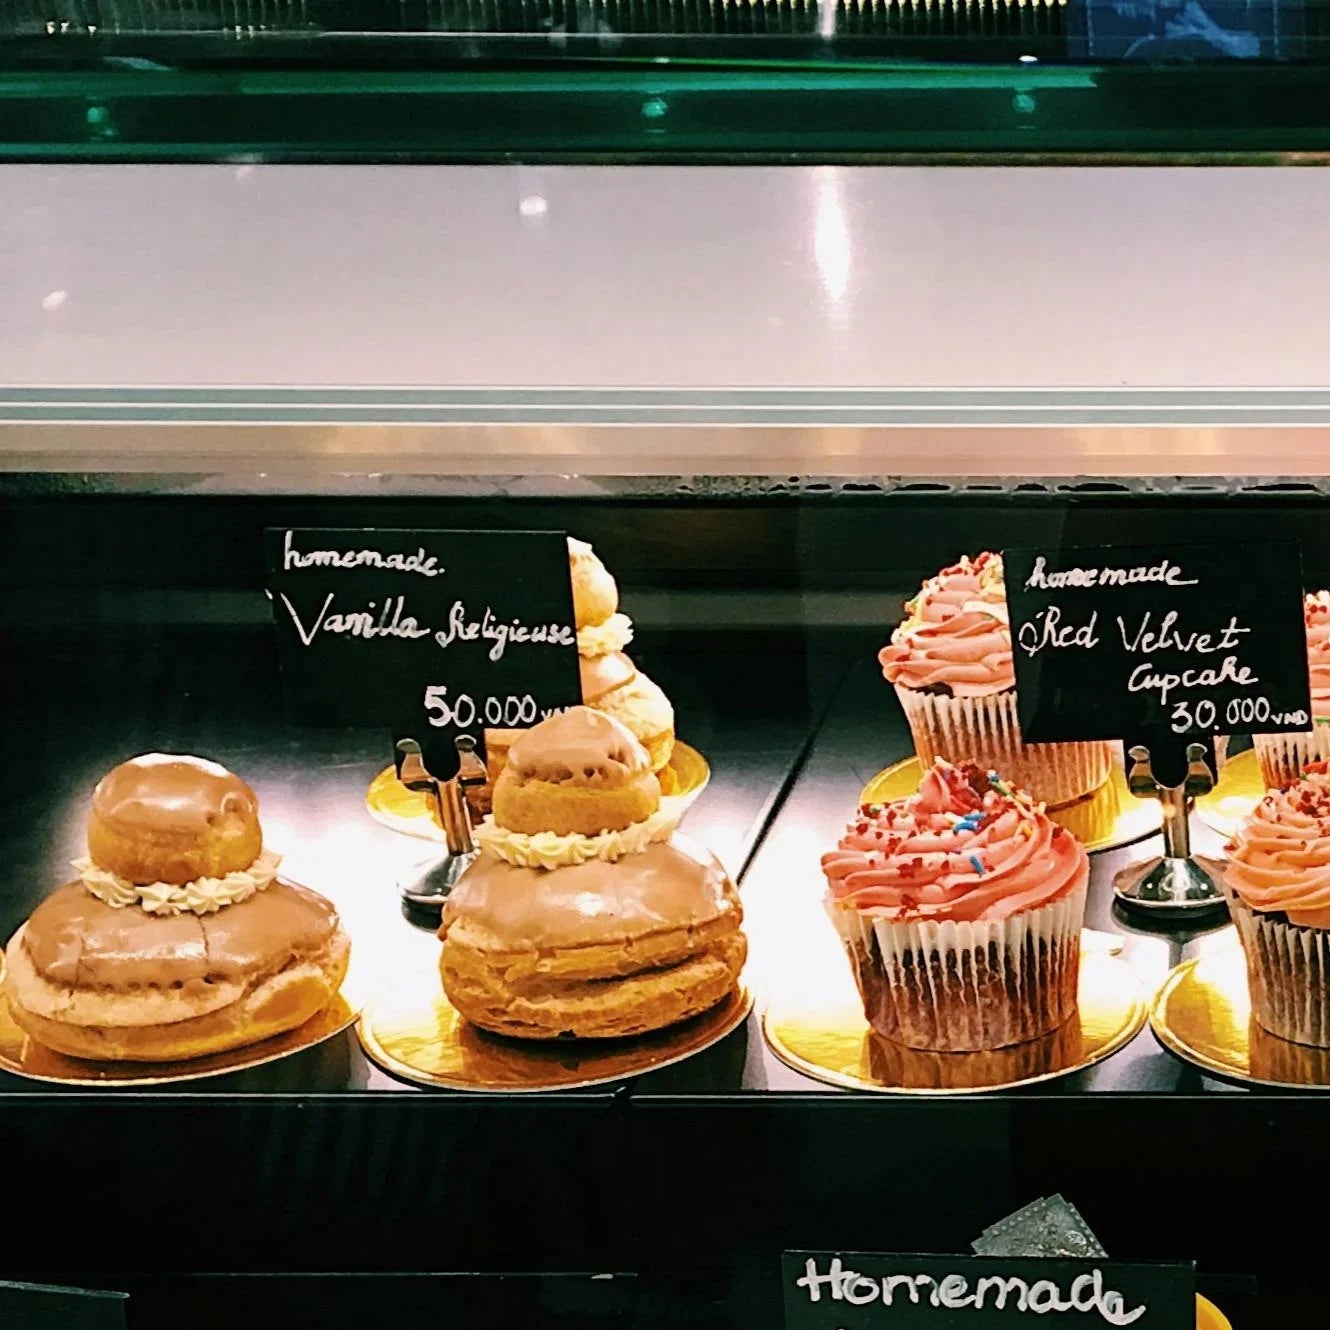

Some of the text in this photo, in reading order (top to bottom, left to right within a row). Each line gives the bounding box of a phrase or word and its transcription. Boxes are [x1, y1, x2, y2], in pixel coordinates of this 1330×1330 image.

[1024, 557, 1198, 591] homemade
[265, 590, 430, 645] Vanilla
[1019, 606, 1250, 657] Red Velvet
[1124, 652, 1264, 706] Cupcake
[797, 1257, 1146, 1325] Homemade
